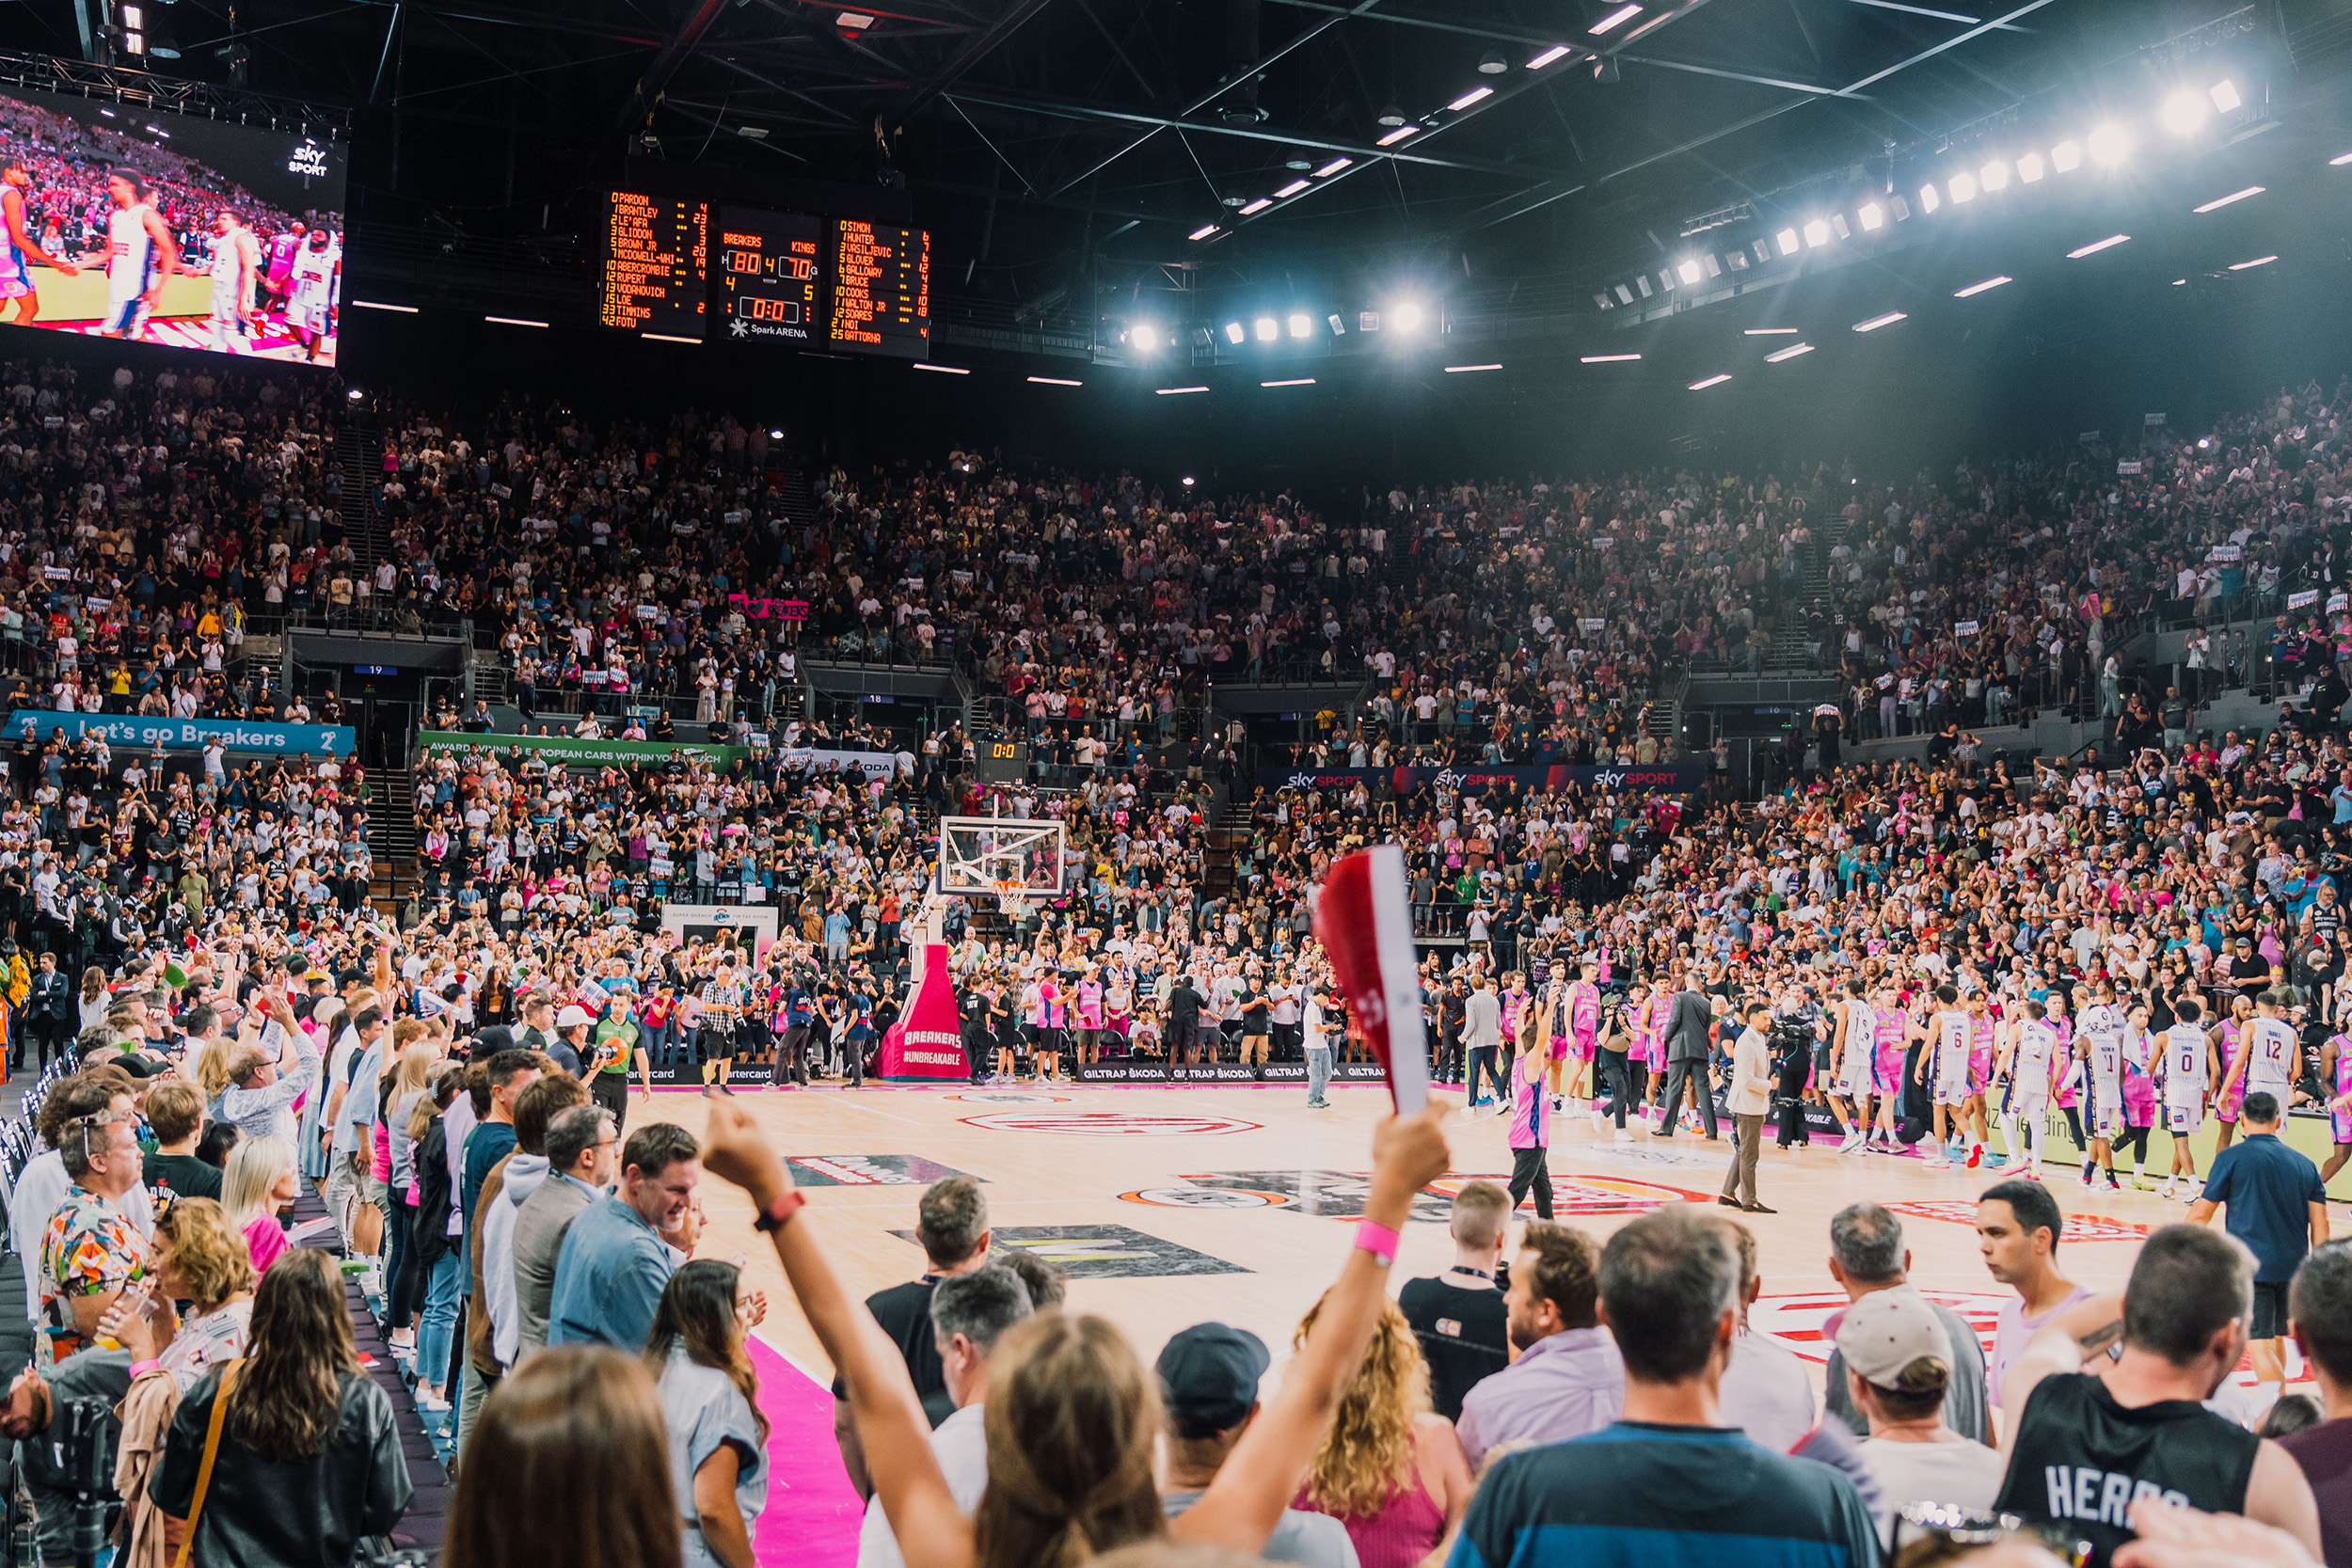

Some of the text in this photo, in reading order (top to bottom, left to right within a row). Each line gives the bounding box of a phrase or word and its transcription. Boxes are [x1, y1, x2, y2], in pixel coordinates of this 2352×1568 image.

[294, 145, 326, 165] sky
[289, 161, 326, 177] SPORT
[612, 192, 707, 213] 0 PARDON 4
[614, 204, 707, 224] 1 BRANTLEY 23
[611, 214, 707, 235] 2 LE'AFA 5
[840, 220, 930, 242] 0 SIMON 6
[611, 226, 707, 246] 3 GLIDDON 3
[723, 232, 762, 247] BREAKERS
[843, 231, 930, 252] 1 HUNTER 7
[611, 237, 707, 258] 5 BROWN JR 20
[791, 241, 816, 255] KINGS
[839, 242, 929, 262] 3 VASILJEVIC 6
[611, 248, 707, 268] 7 MCDOWELL-WHI 19
[734, 251, 760, 273] 80
[765, 258, 774, 273] 4
[839, 253, 929, 274] 5 GLOVER 12
[606, 260, 706, 280] 10 ABERCROMBIE 4
[788, 257, 810, 279] 70
[838, 263, 929, 284] 6 GALLOWAY 4
[606, 271, 646, 285] 12 RUPERT
[725, 276, 736, 292] 4
[839, 275, 928, 294] 7 BRUCE 3
[606, 282, 665, 298] 13 VODANOVICH
[803, 284, 813, 301] 5
[835, 286, 928, 306] 10 COOKS 10
[602, 304, 651, 319] 33 TIMMINS
[606, 293, 705, 314] 15 LOE 2
[754, 298, 784, 321] 0:0
[835, 296, 928, 317] 11 WALTON JR 18
[602, 315, 637, 328] 42 FOTU
[835, 308, 873, 322] 12 SOARES
[751, 325, 807, 339] Spark ARENA
[831, 328, 881, 344] 25 GATTORNA
[832, 318, 927, 339] 21 NOI 4
[1835, 614, 1843, 625] 12
[370, 665, 382, 674] 19
[870, 694, 882, 703] 18
[143, 727, 173, 744] go
[525, 747, 582, 758] EROPEAN
[588, 751, 613, 760] CARS
[615, 752, 654, 762] WITHIN
[993, 743, 1015, 759] 0:0
[1288, 772, 1316, 789] sky
[1595, 769, 1677, 787] sky SPORT
[904, 1031, 961, 1049] BREAKERS
[1954, 1032, 1963, 1049] 6
[2266, 1038, 2281, 1060] 12
[903, 1051, 961, 1066] #UNBREAKABLE
[2182, 1054, 2192, 1073] 0
[728, 1069, 771, 1079] astercard
[1084, 1068, 1166, 1079] GILTRAP ŠKODA
[1216, 1067, 1252, 1079] ŠKODA
[1264, 1068, 1305, 1077] GILTRAP
